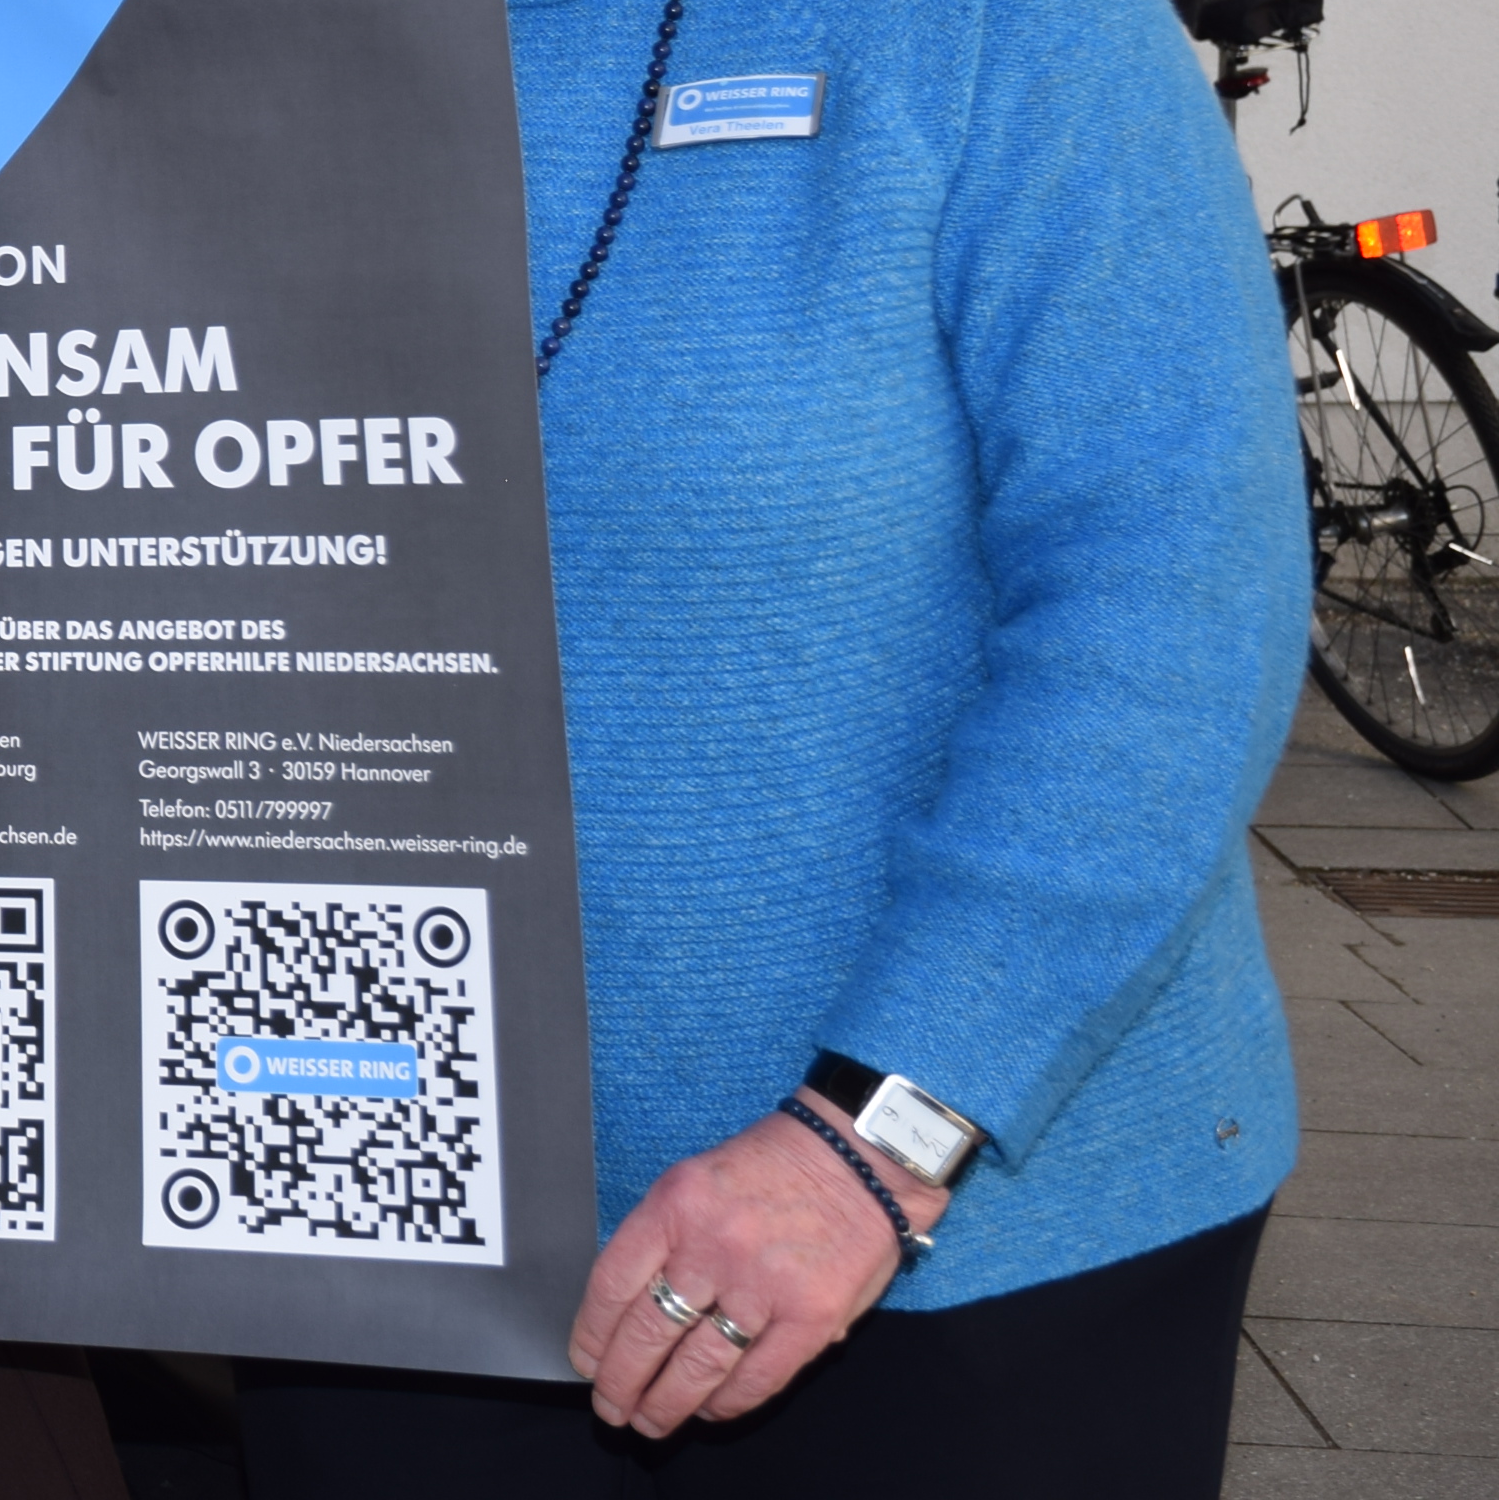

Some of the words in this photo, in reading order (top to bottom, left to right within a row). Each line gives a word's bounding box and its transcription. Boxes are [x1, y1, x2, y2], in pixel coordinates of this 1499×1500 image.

[705, 88, 767, 102] WEISSER
[771, 86, 809, 98] RING
[13, 408, 174, 490] FÜR
[195, 417, 463, 488] OPFER
[63, 529, 386, 567] UNTERSTÜTZUNG!
[0, 617, 61, 640] ÜBER
[67, 620, 113, 640] DAS
[118, 620, 236, 640] ANGEBOT
[242, 620, 286, 640] DES
[25, 652, 143, 671] STIFTUNG
[148, 652, 290, 672] OPFERHILFE
[296, 652, 499, 673] NIEDERSACHSEN.
[138, 731, 220, 750] WEISSER
[226, 732, 277, 750] RING
[282, 733, 313, 751] e.V.
[319, 732, 453, 753] Niedersachsen
[139, 760, 243, 783] Georgswall
[249, 761, 261, 779] 3
[282, 761, 335, 780] 30159
[341, 763, 431, 782] Hannover
[139, 799, 210, 818] Telefon:
[215, 800, 332, 820] 0511/799997
[140, 827, 527, 859] https://www.niedersachsen.weisser-ring.de
[266, 1057, 353, 1077] WEISSER
[360, 1060, 411, 1081] RING
